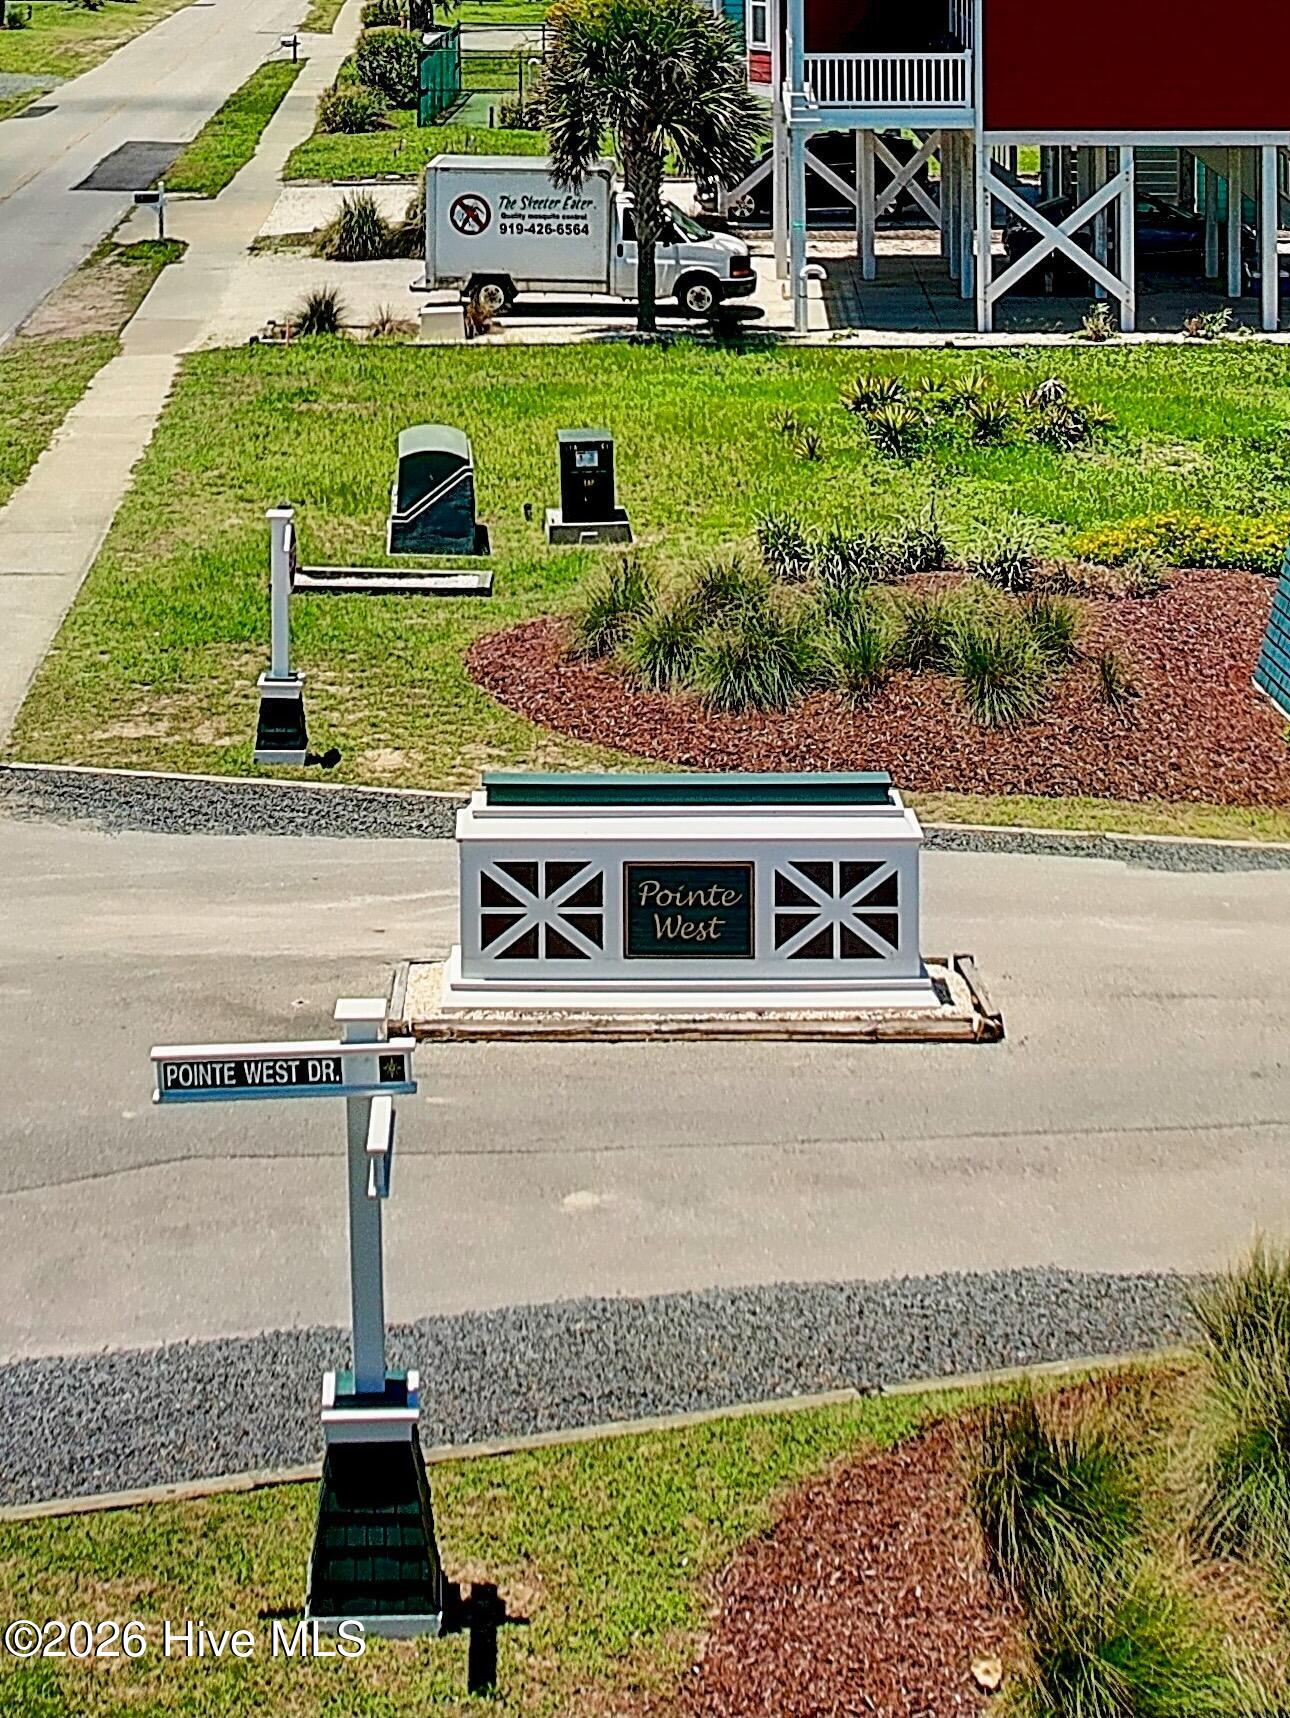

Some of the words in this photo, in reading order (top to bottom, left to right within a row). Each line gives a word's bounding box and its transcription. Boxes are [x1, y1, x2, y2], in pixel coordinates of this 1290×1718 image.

[499, 195, 517, 210] The
[520, 195, 560, 210] Skeeter
[500, 223, 589, 235] 919-426-6564
[638, 880, 743, 907] Pointe
[653, 913, 726, 941] West
[166, 1062, 236, 1087] POINTE
[243, 1060, 301, 1085] WEST
[307, 1059, 341, 1083] DR.
